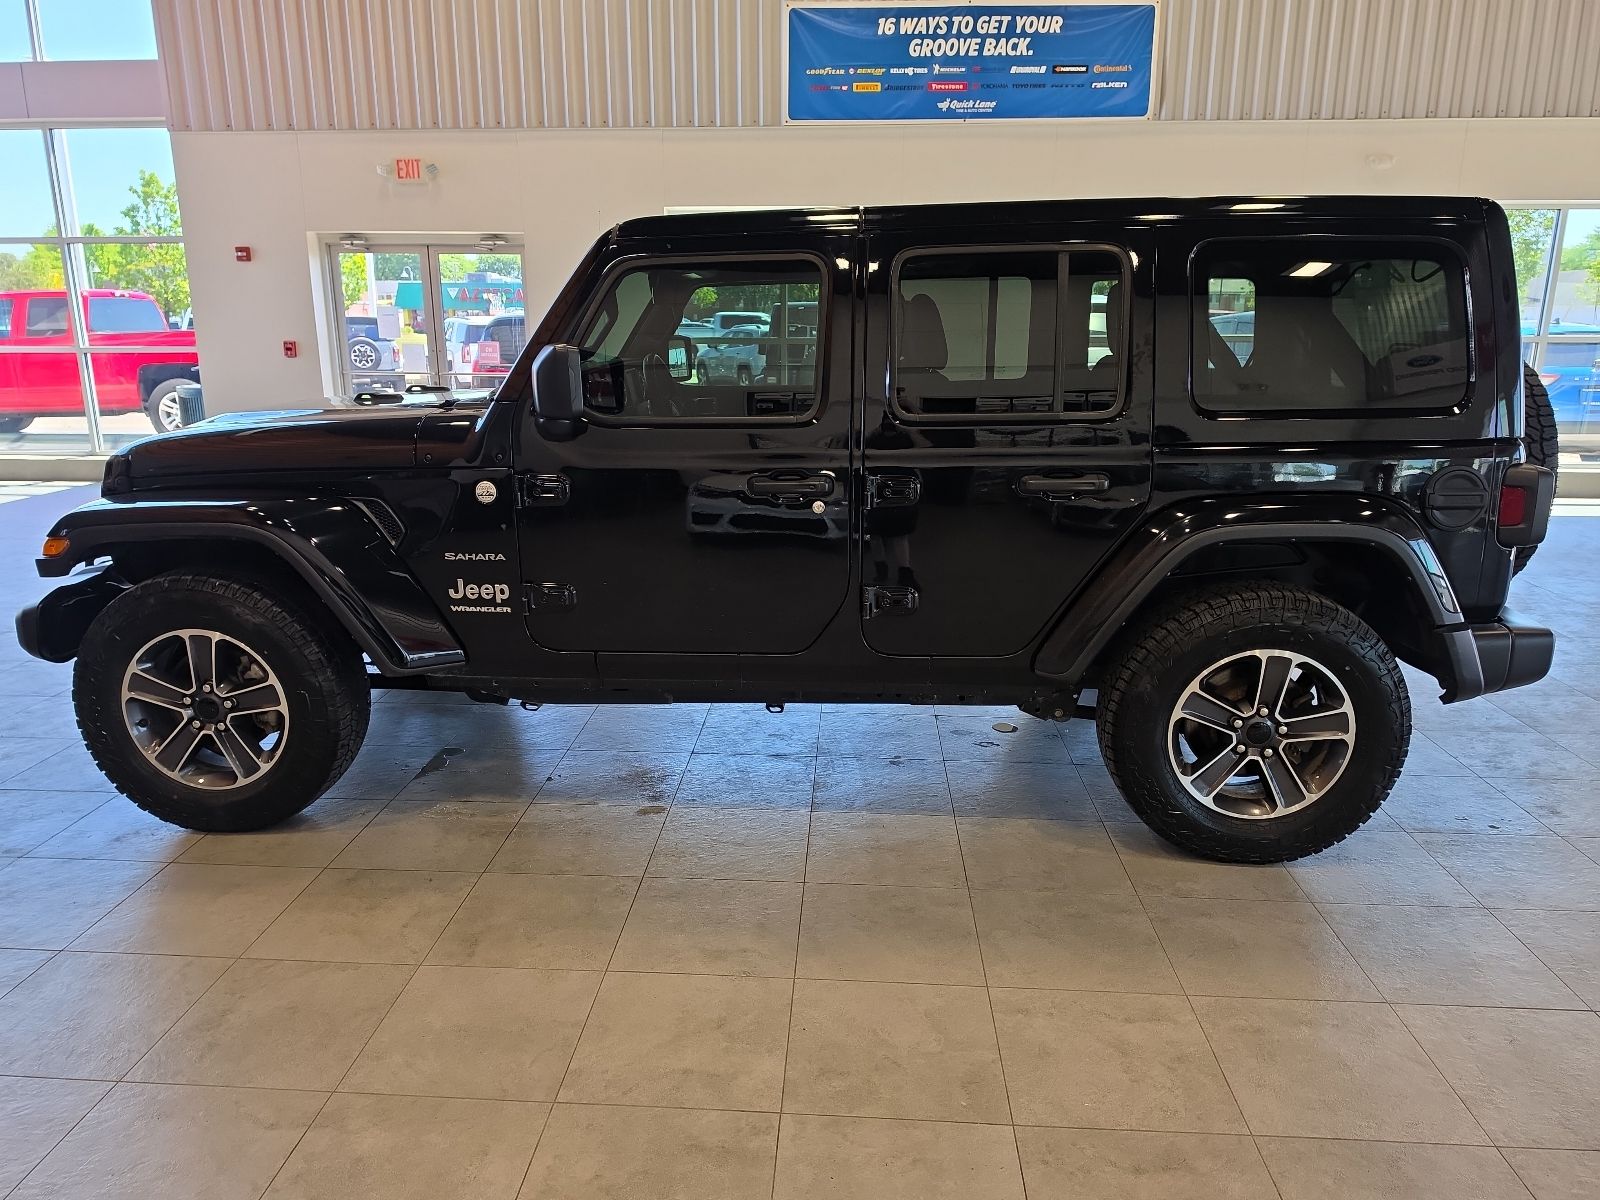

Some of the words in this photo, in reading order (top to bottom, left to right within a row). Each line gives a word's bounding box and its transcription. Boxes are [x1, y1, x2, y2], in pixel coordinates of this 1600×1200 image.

[877, 17, 896, 35] 16
[899, 16, 949, 35] WAYS
[951, 15, 974, 34] TO
[976, 15, 1012, 34] GET
[1015, 15, 1064, 34] YOUR
[908, 37, 982, 57] GROOVE
[982, 37, 1034, 56] BACK.
[1093, 65, 1128, 74] Continental
[1091, 81, 1128, 89] FALKEN
[950, 100, 975, 109] Quick
[975, 100, 997, 108] Lane
[396, 159, 421, 179] EXIT
[444, 552, 506, 561] SAHARA
[448, 578, 510, 603] Jeep
[450, 605, 512, 613] WRANGLER
